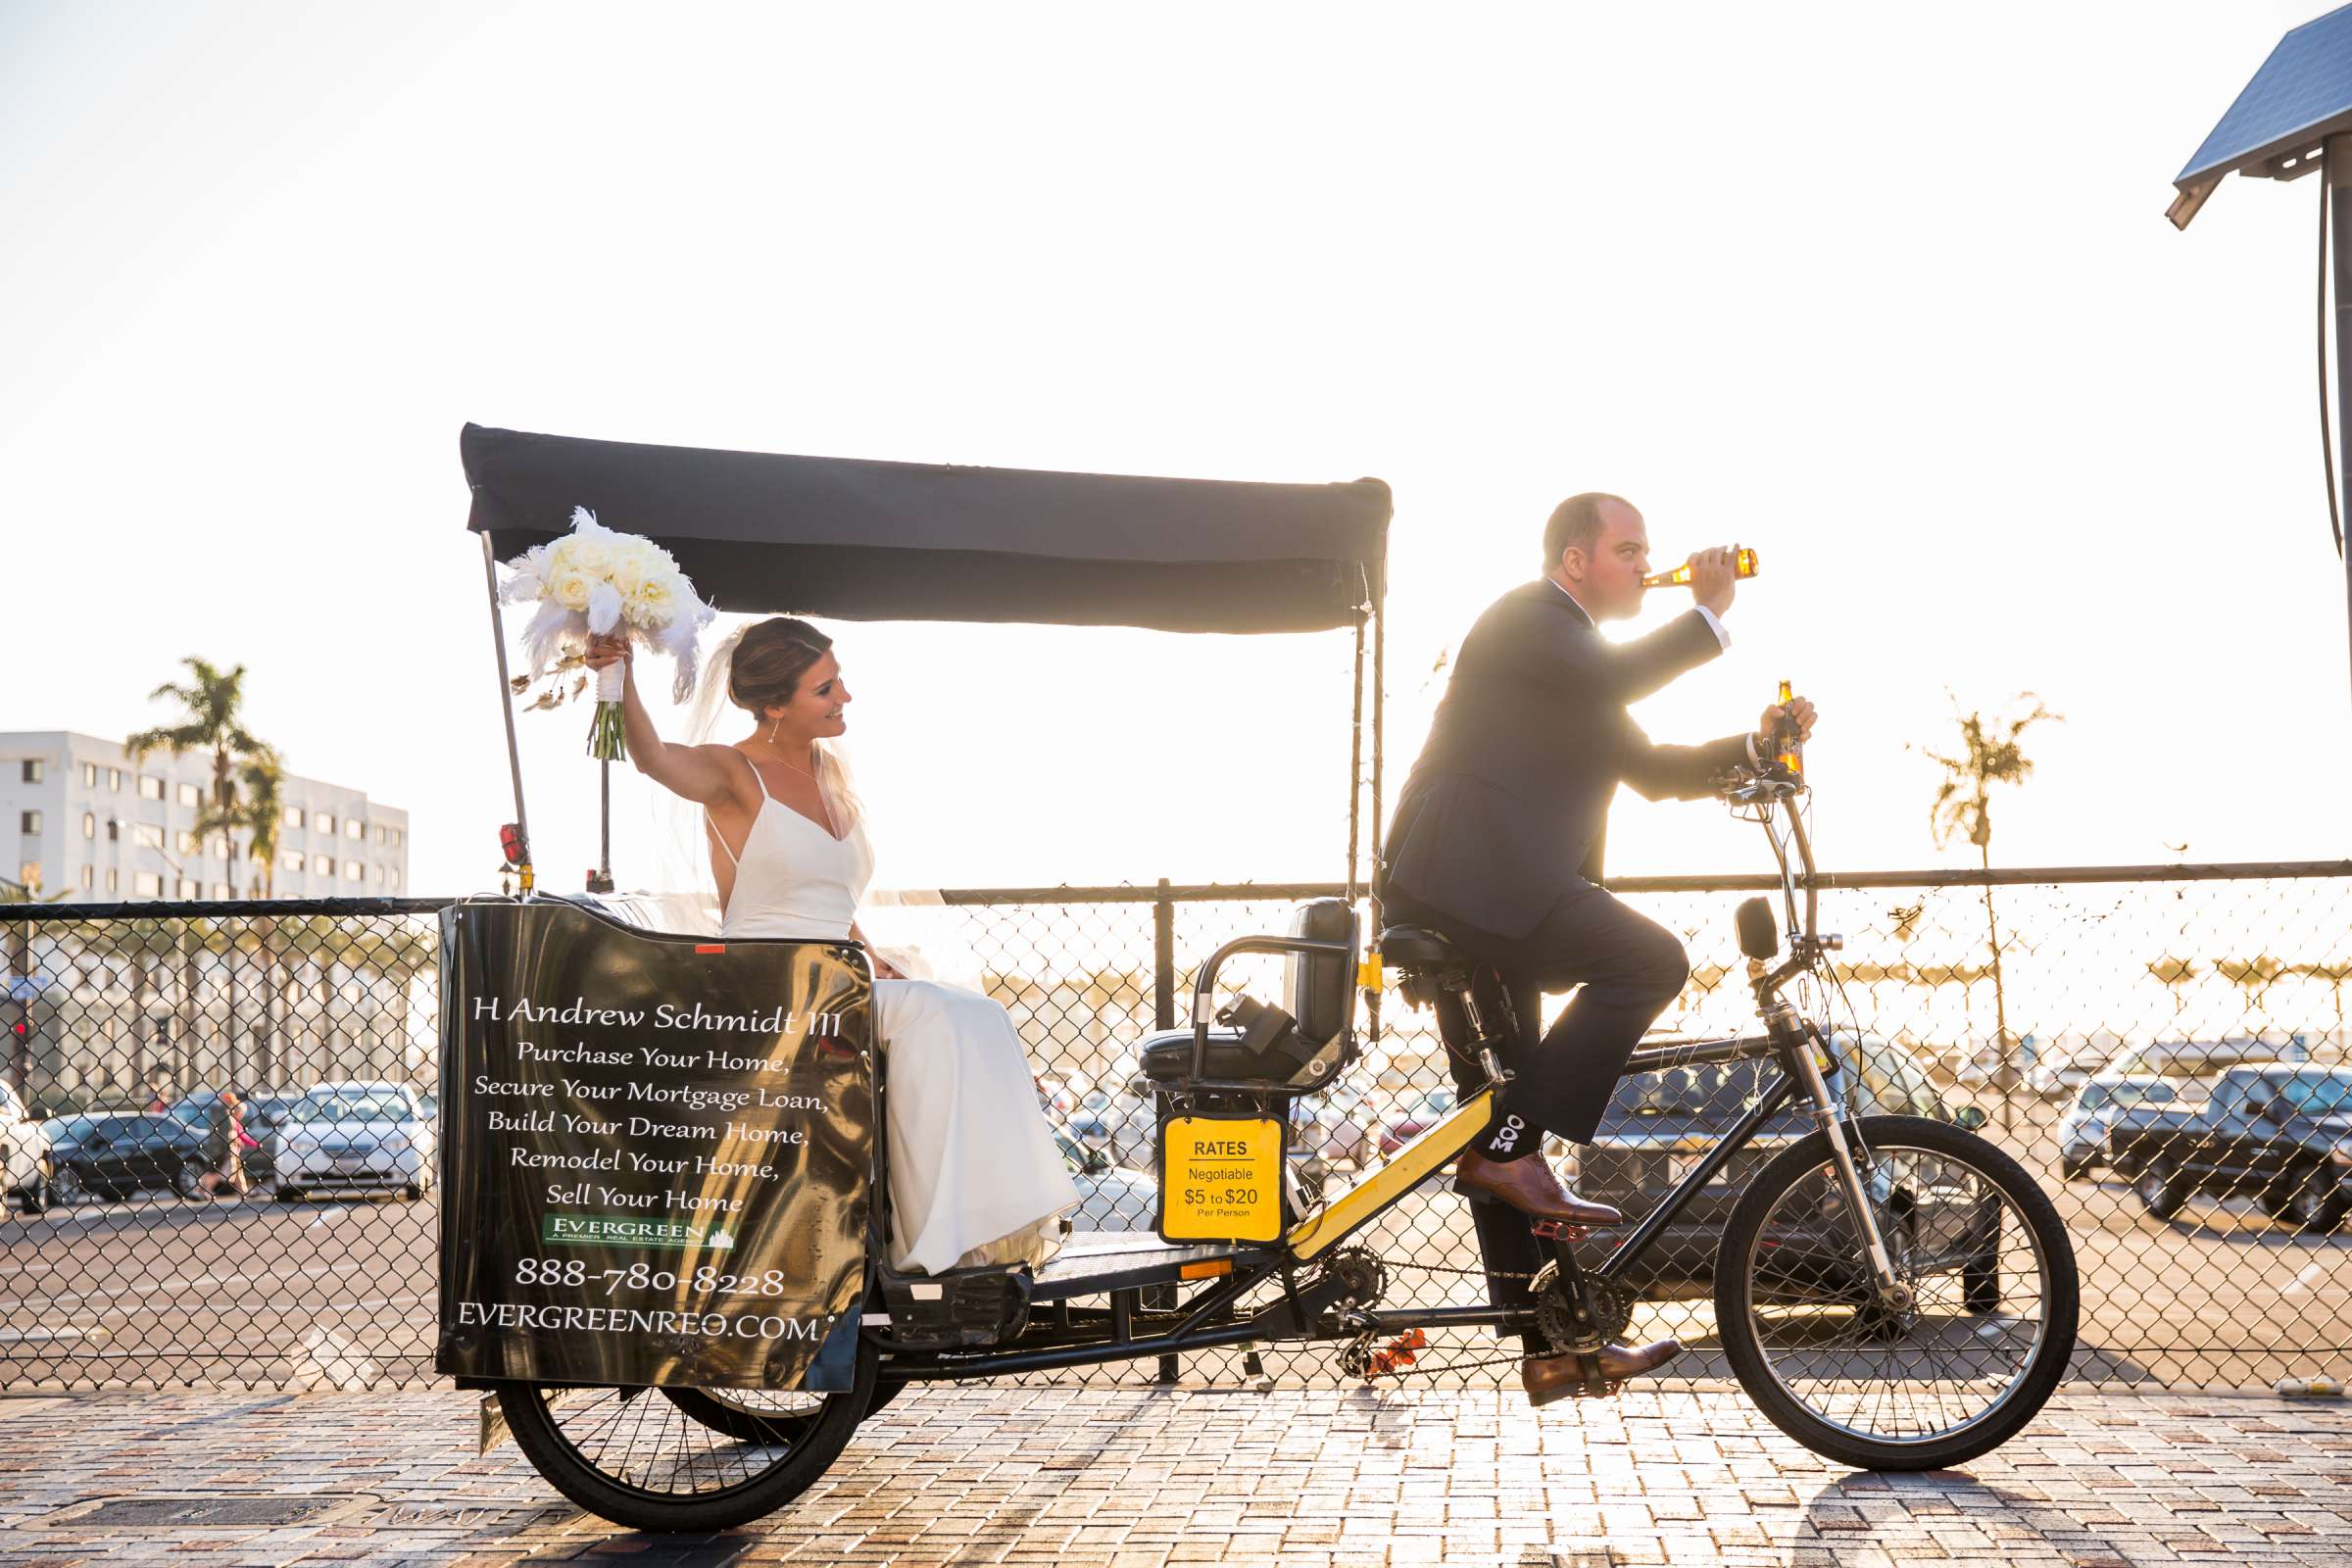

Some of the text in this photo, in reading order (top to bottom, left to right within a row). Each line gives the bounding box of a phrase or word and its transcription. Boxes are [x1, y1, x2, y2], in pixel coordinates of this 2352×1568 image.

[473, 996, 841, 1037] H Andrew Schmidt III
[516, 1043, 790, 1074] Purchase Your Home,
[474, 1076, 829, 1113] Secure Your Mortgage Loan,
[488, 1110, 809, 1147] Build Your Dream Home,
[511, 1148, 779, 1181] Remodel Your Home,
[1195, 1142, 1248, 1155] RATES
[1189, 1168, 1252, 1182] Negotiable
[546, 1184, 743, 1212] Sell Your Home
[1185, 1189, 1258, 1205] $5 to $20
[553, 1217, 705, 1238] EVERGREEN
[515, 1257, 784, 1296] 888-780-8228
[458, 1301, 820, 1341] EVERGREENREO.COM
